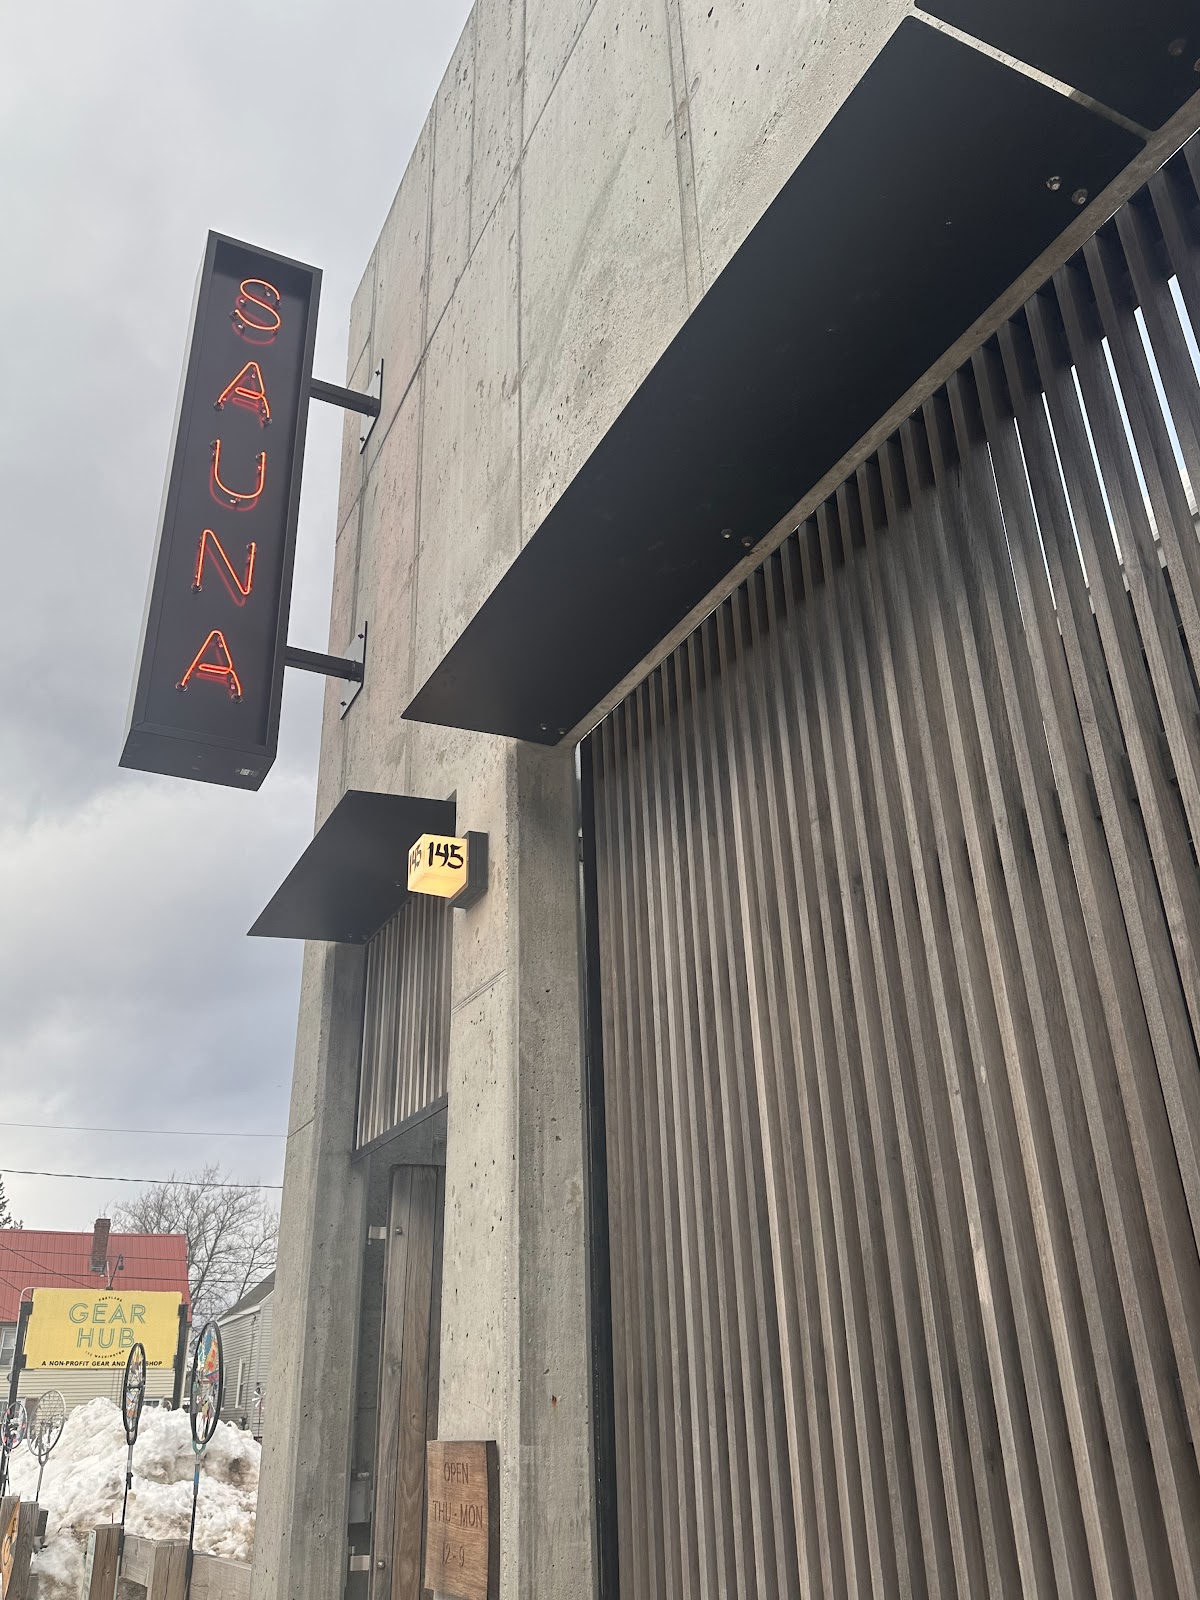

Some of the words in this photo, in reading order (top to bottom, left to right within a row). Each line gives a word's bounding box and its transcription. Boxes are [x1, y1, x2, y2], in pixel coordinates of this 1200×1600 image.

[175, 278, 282, 702] SAUNA
[428, 841, 464, 869] 145
[69, 1303, 146, 1324] GEAR
[77, 1328, 135, 1348] HUB
[443, 1462, 469, 1485] OPEN
